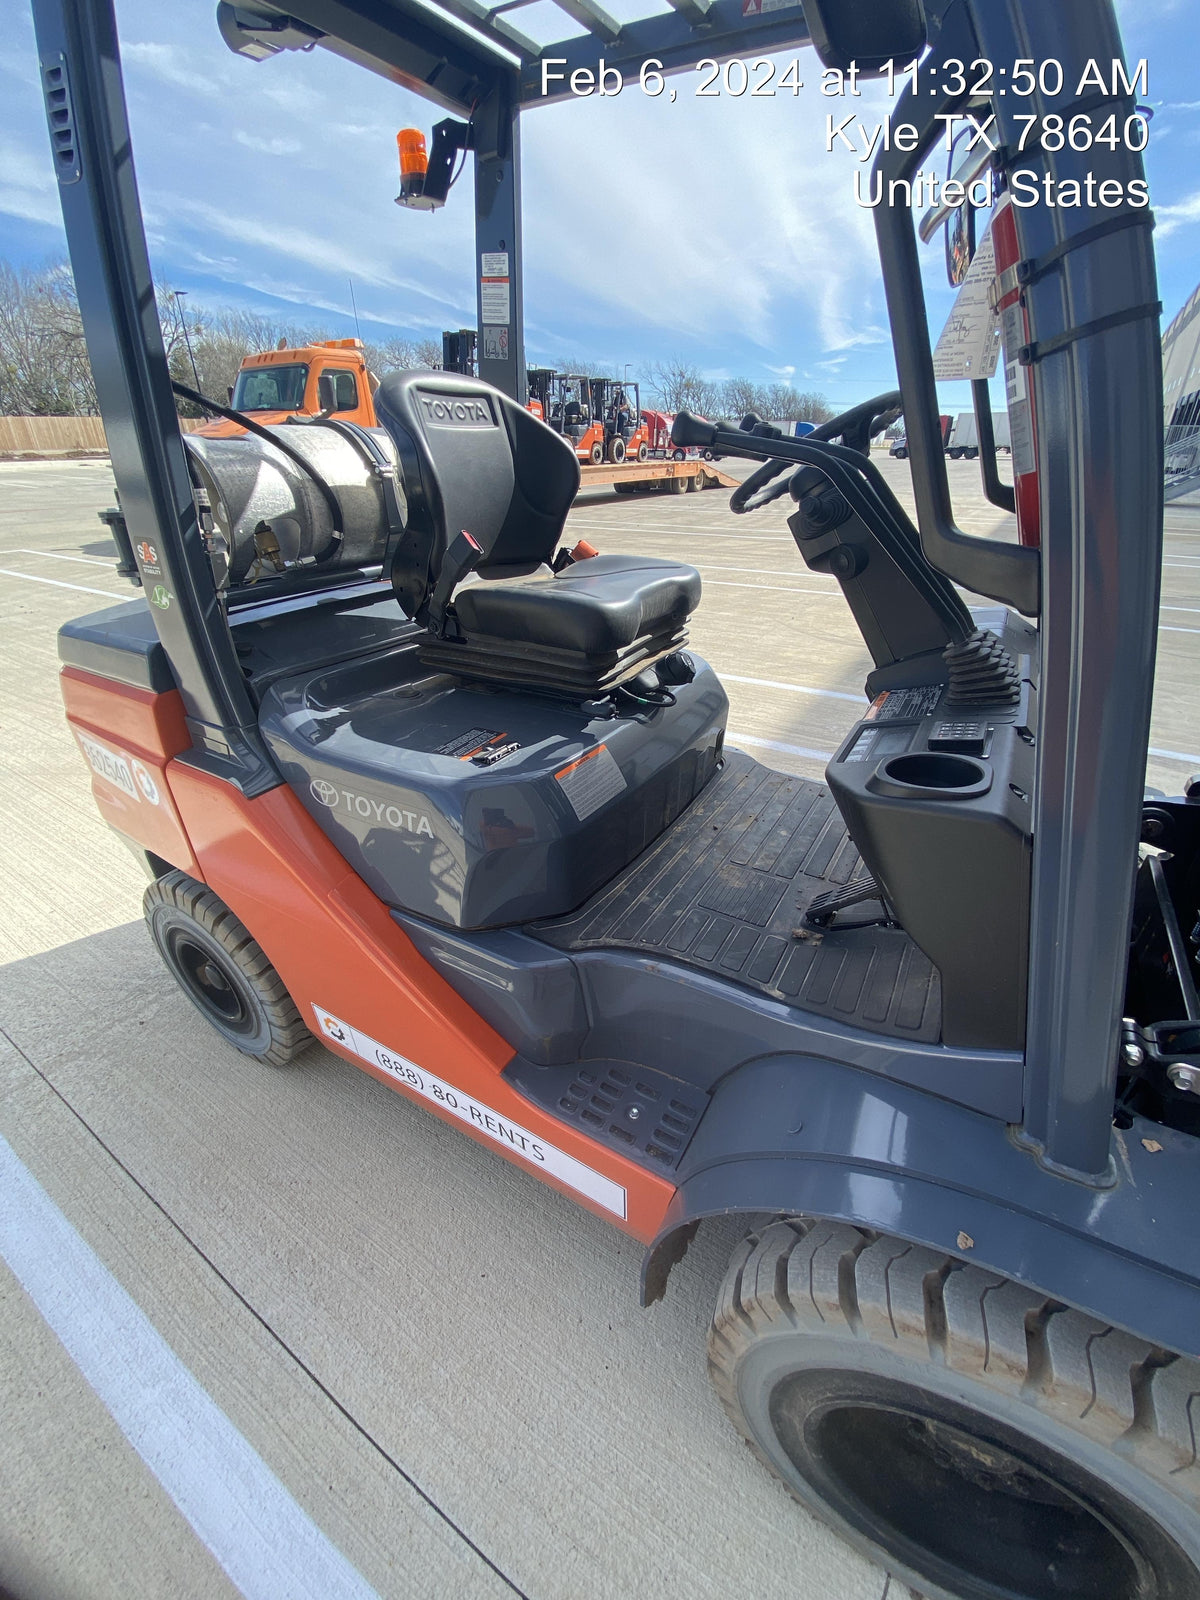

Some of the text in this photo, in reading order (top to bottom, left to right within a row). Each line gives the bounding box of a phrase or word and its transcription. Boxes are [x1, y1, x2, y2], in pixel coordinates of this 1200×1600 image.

[421, 398, 489, 421] TOYOTA
[137, 542, 158, 565] SAS
[341, 790, 434, 839] TOYOTA
[375, 1049, 546, 1162] (888) 80-RENTS
